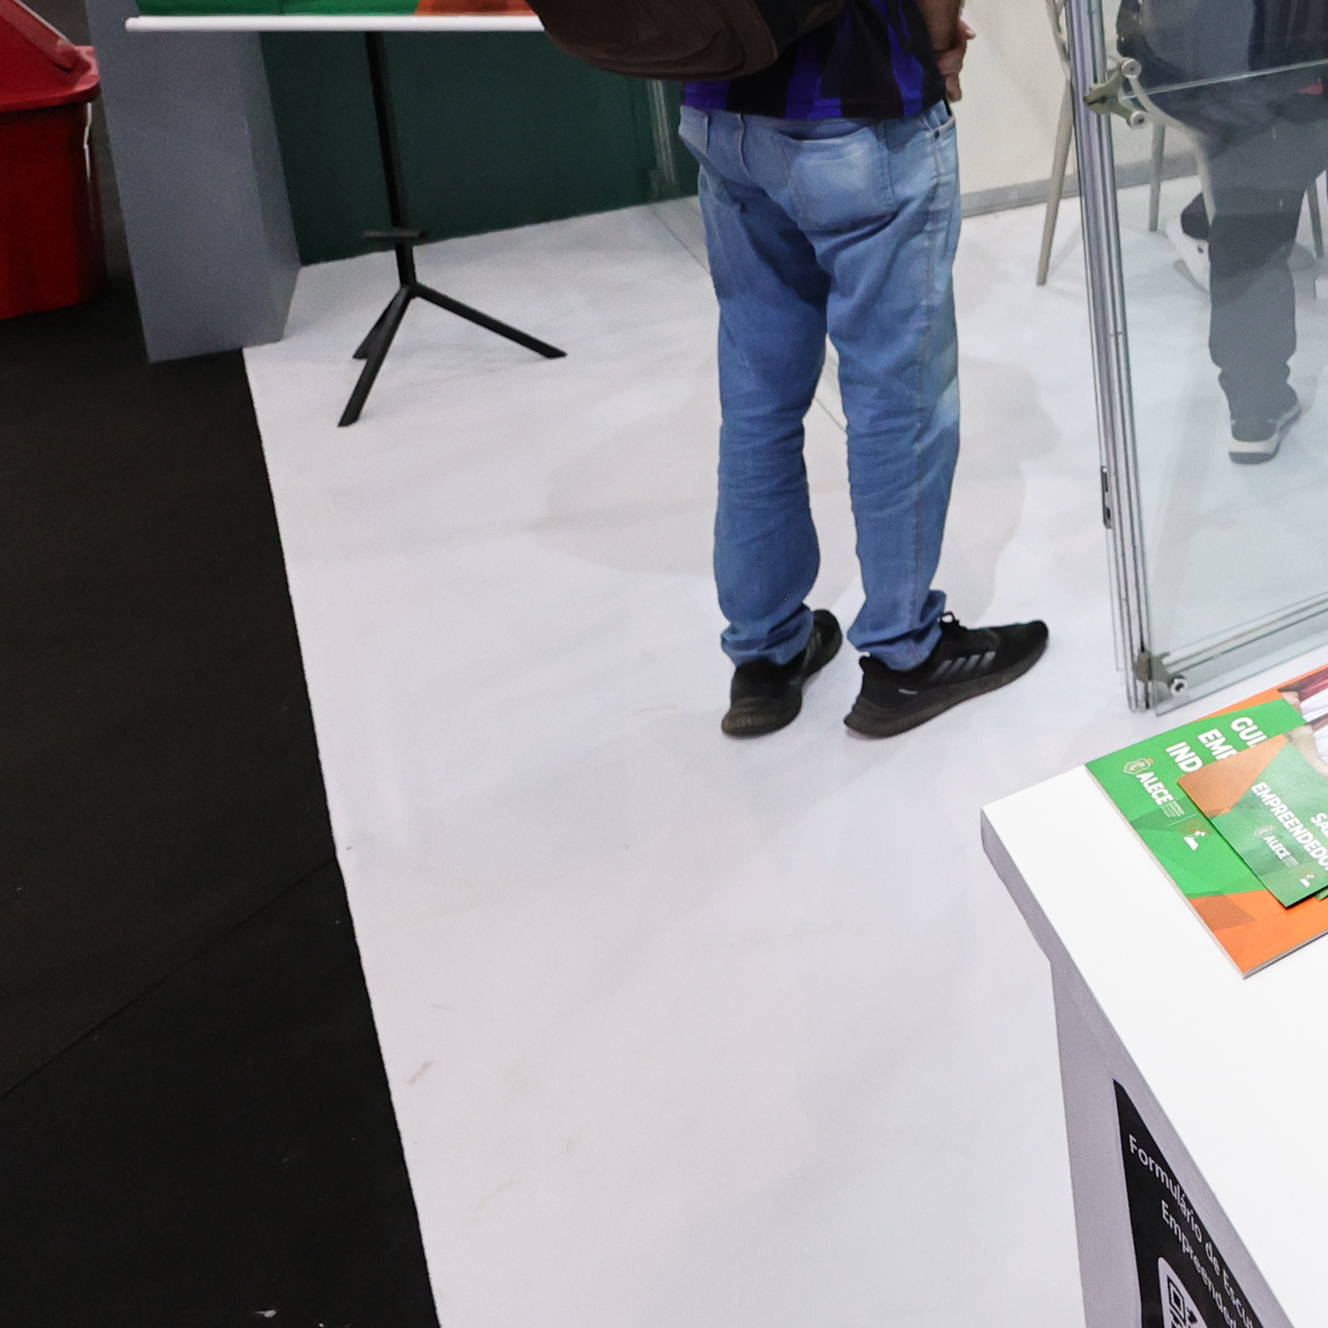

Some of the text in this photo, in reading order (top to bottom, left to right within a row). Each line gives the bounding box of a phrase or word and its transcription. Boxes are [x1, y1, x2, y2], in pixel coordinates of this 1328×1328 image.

[1230, 717, 1268, 748] GUI
[1136, 771, 1175, 806] ALECE
[1264, 835, 1290, 860] ALECE
[1129, 1134, 1202, 1243] Formulário
[1205, 1241, 1220, 1276] de
